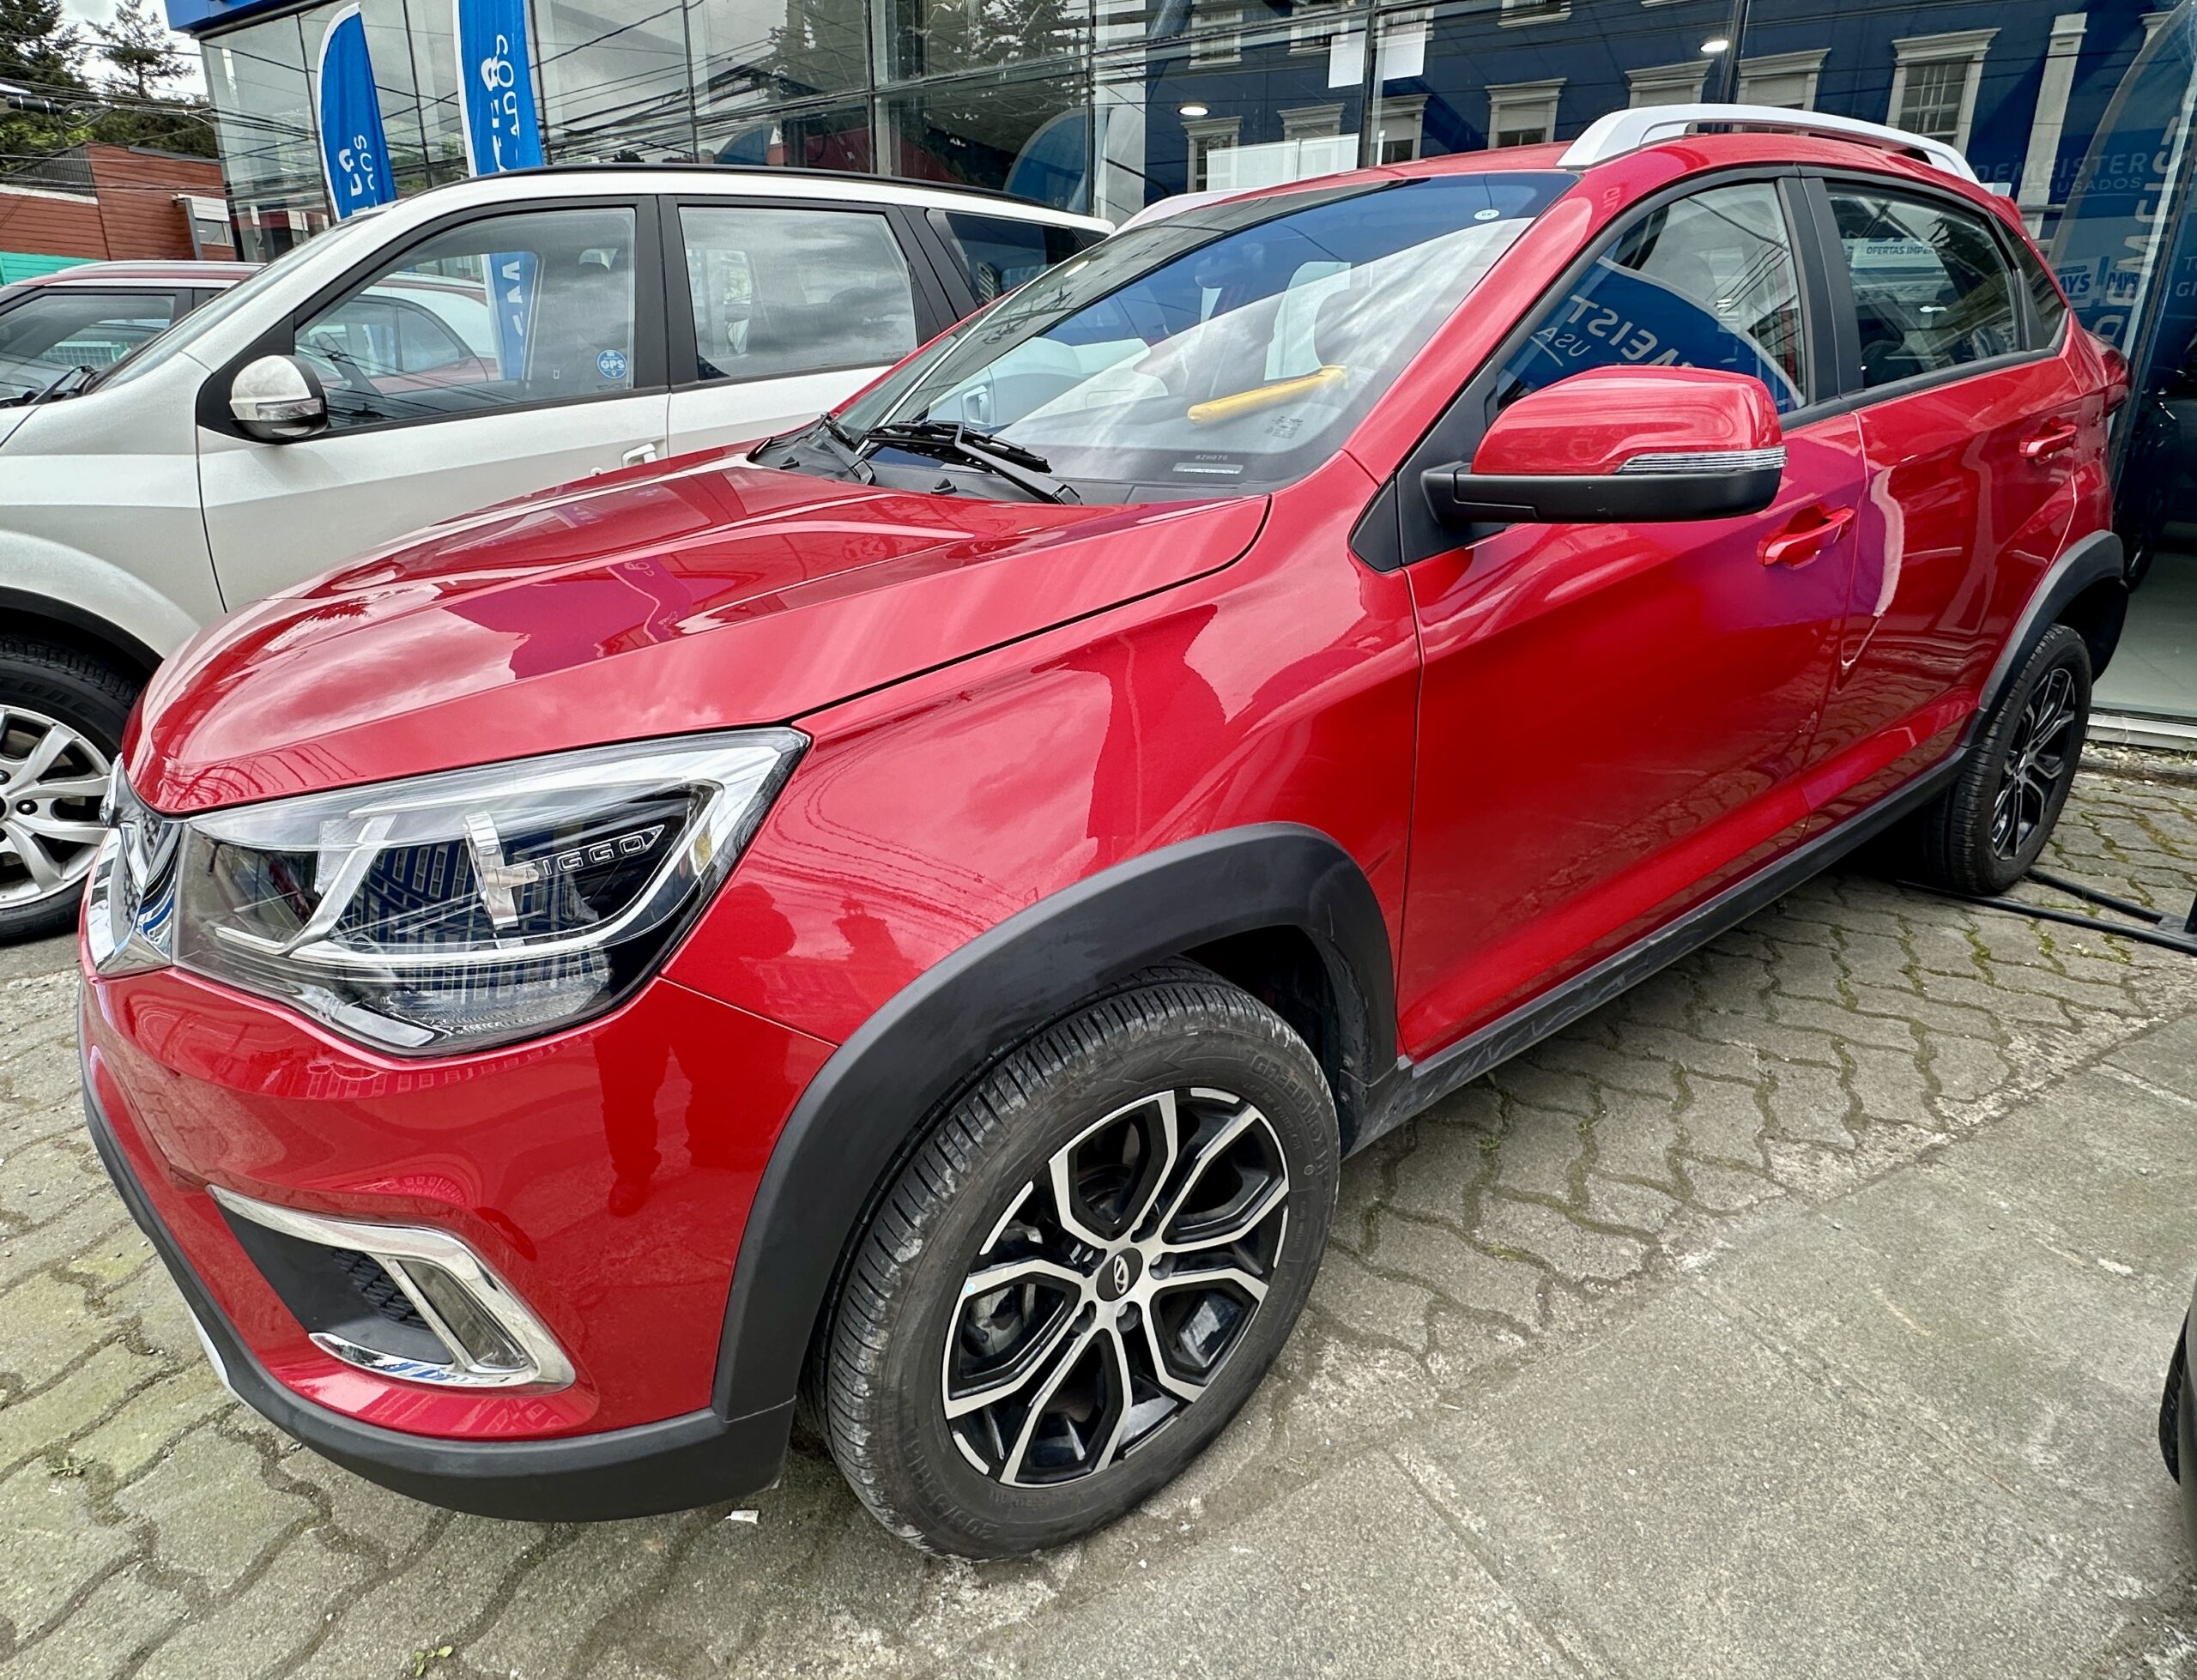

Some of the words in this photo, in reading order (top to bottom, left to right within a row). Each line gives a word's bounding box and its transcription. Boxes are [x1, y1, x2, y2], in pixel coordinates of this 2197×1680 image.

[2056, 177, 2142, 193] USADOS
[1867, 245, 1904, 255] OFERTAS
[600, 360, 625, 369] GPS
